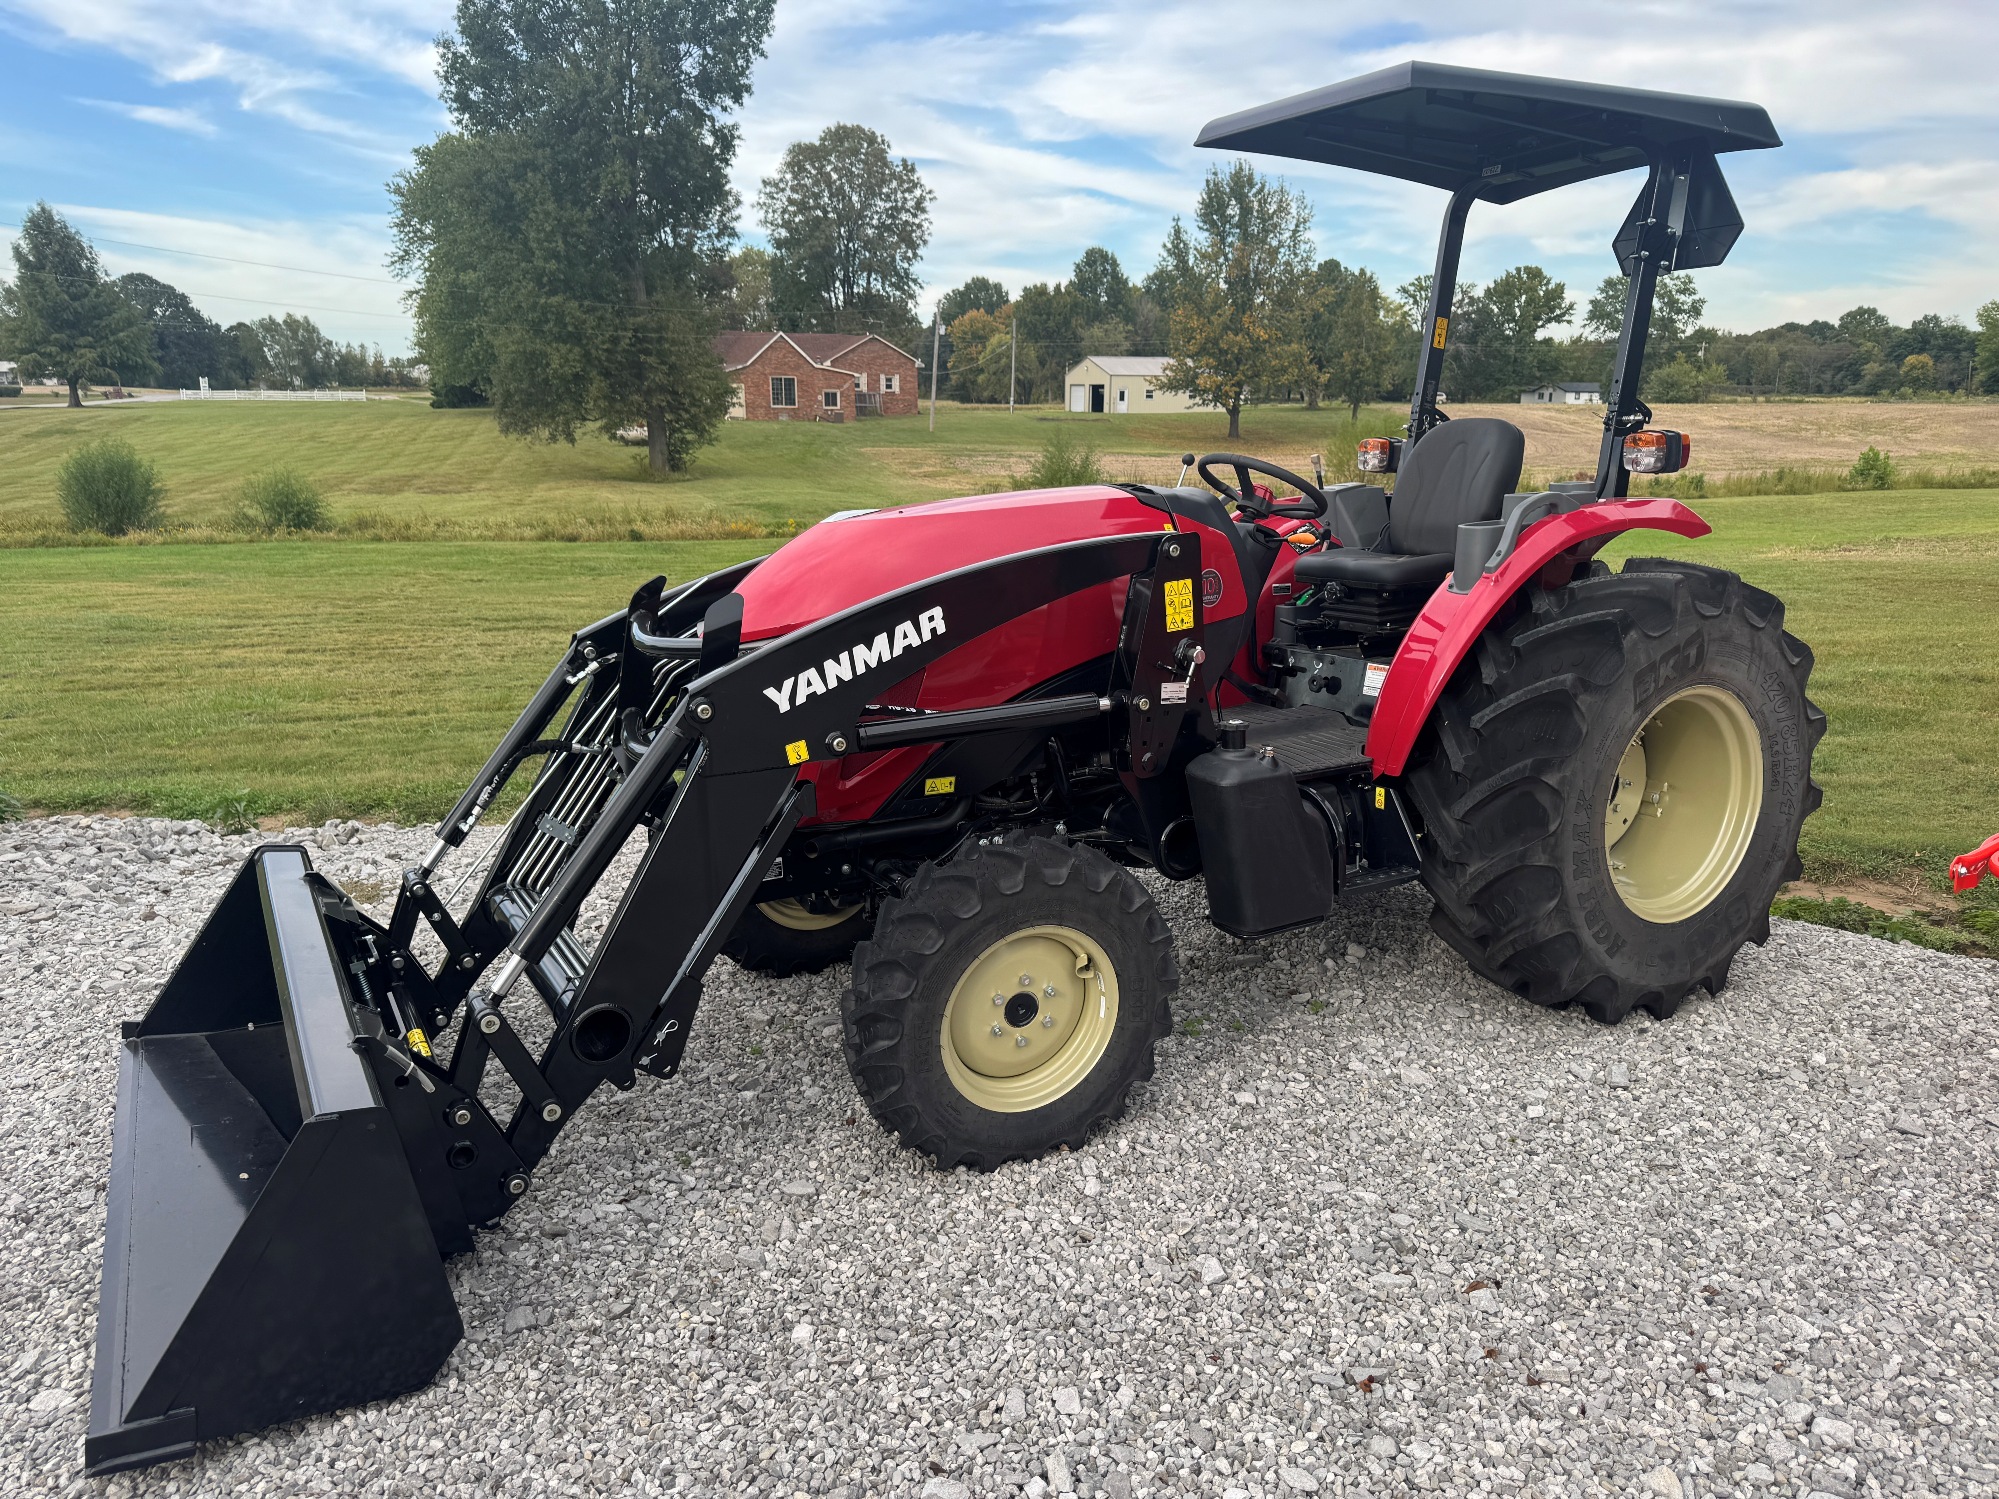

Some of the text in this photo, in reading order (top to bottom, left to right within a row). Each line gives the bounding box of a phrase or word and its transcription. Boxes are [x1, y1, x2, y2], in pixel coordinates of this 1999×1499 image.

[763, 605, 946, 714] YANMAR
[1636, 630, 1704, 706] BKT
[1571, 786, 1628, 960] AGRI MAX
